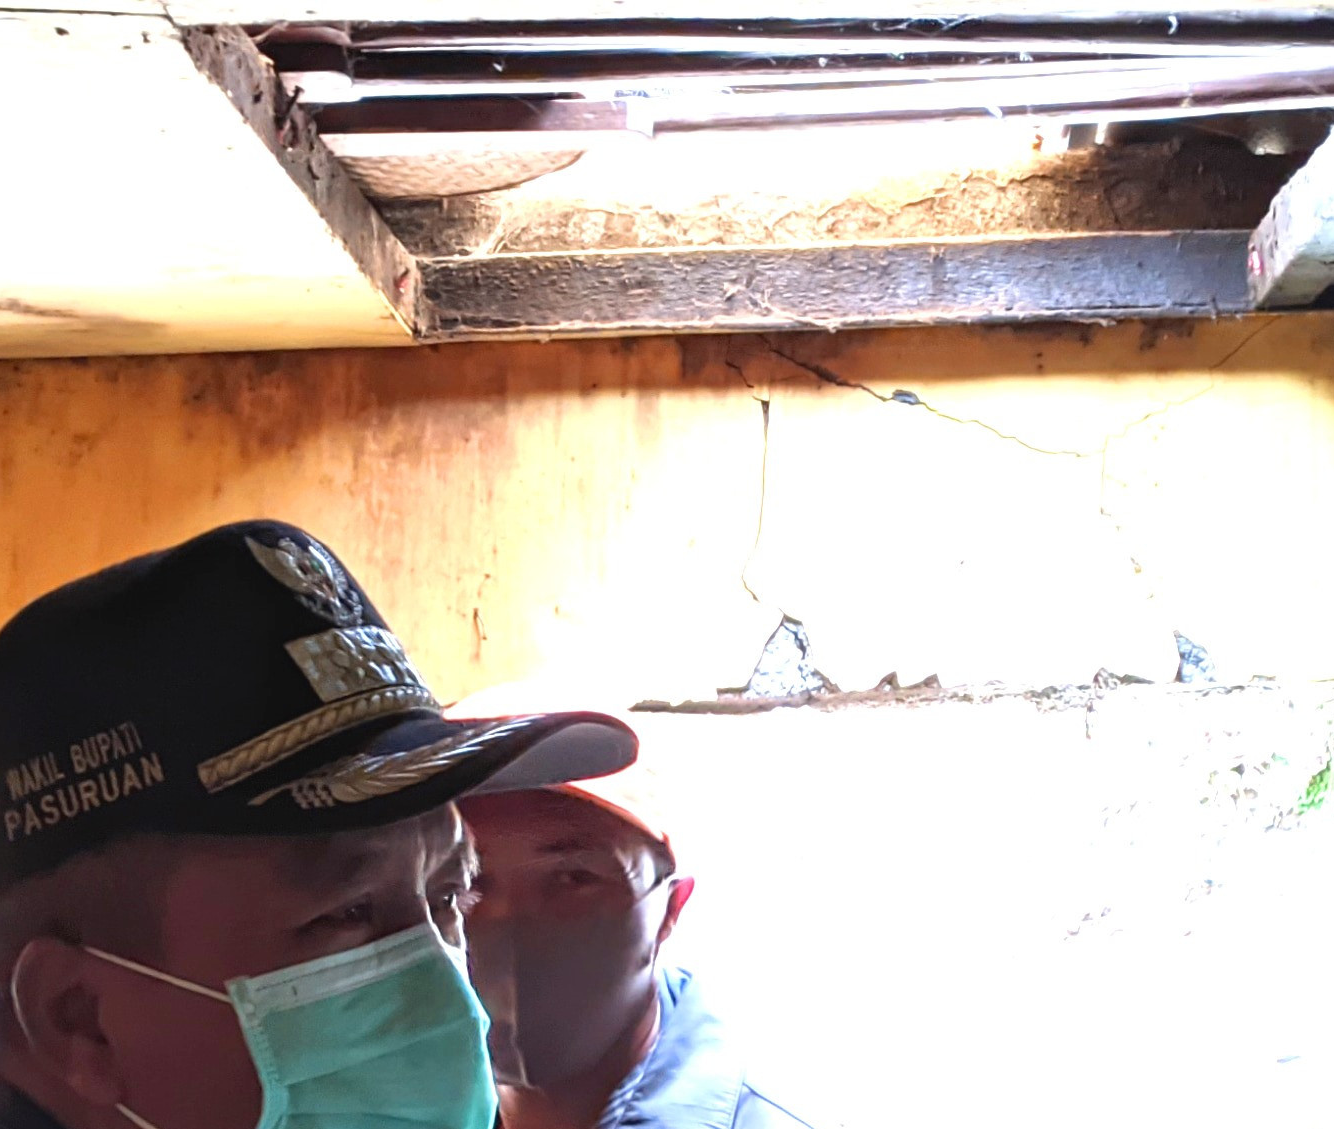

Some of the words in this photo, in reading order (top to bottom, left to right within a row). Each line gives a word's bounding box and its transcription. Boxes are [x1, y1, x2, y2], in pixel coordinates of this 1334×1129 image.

[3, 752, 165, 842] PASURUAN
[6, 751, 65, 801] WAKIL
[69, 720, 142, 775] BUPATI
